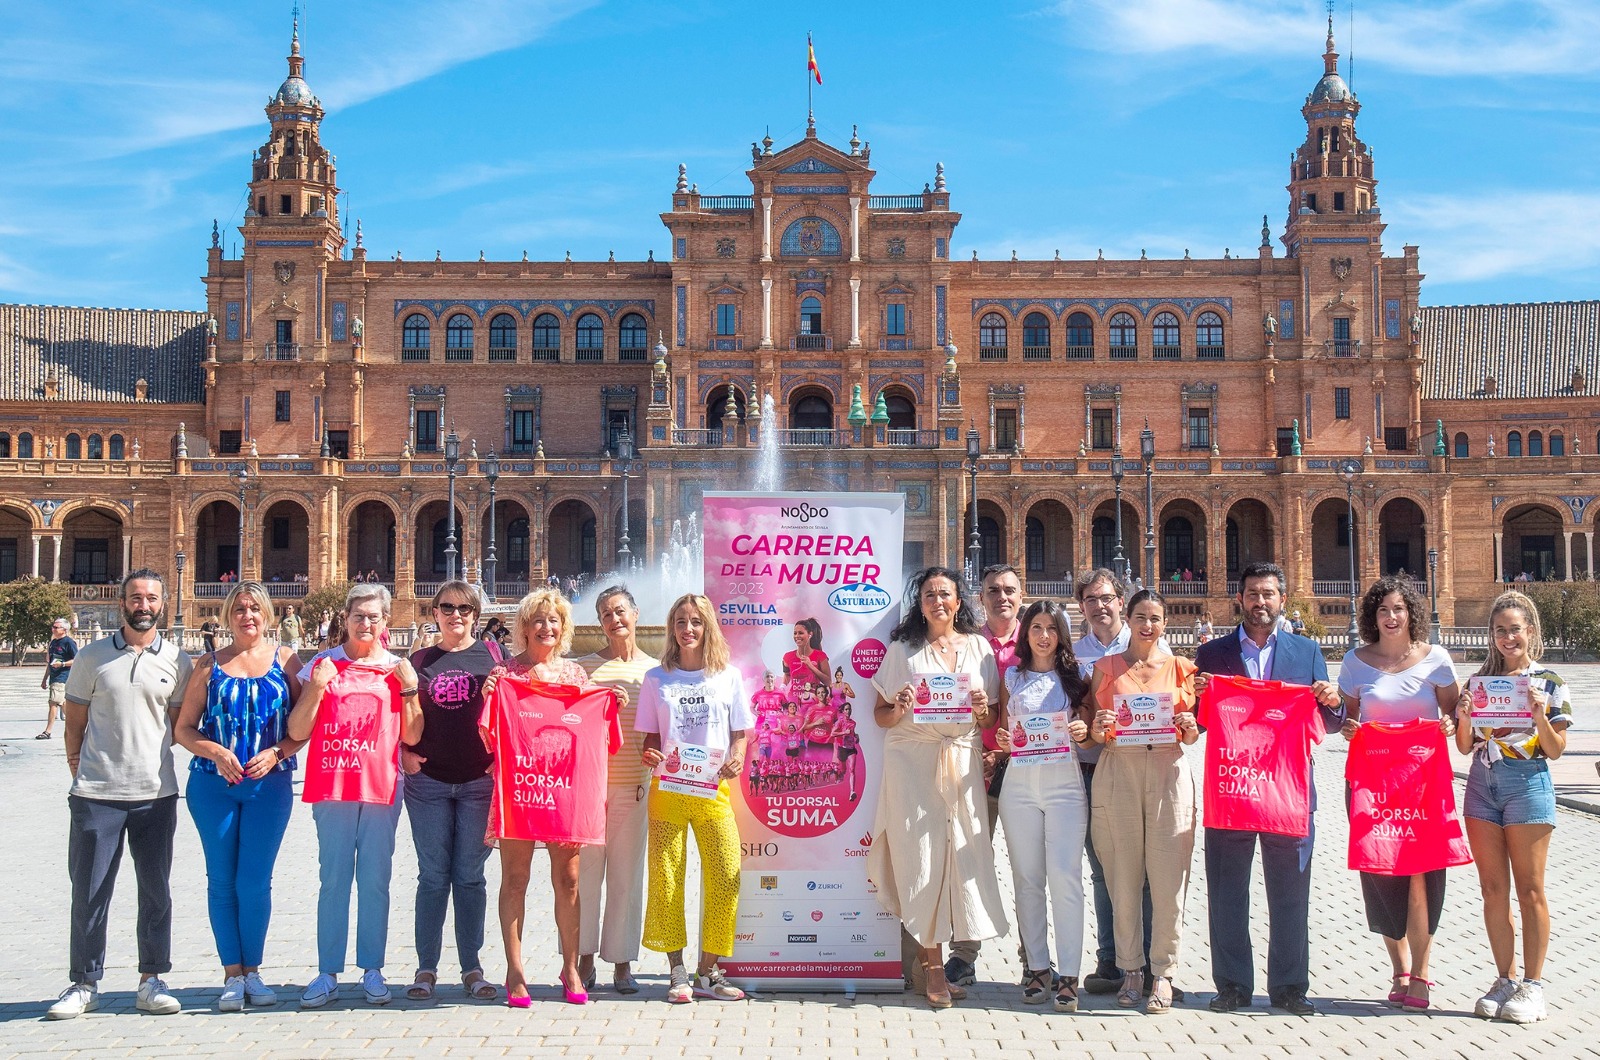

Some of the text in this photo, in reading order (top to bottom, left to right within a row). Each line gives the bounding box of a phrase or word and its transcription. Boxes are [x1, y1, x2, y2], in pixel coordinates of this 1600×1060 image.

[732, 534, 874, 556] CARRERA
[721, 564, 881, 585] DE LA MUJER
[728, 582, 764, 595] 2023
[833, 594, 886, 605] ASTURIANA
[720, 604, 777, 614] SEVILLA
[434, 681, 469, 691] CAN
[435, 690, 470, 703] CER
[679, 696, 705, 704] con
[324, 723, 339, 735] TU
[1029, 733, 1049, 742] 016
[323, 739, 376, 752] DORSAL
[1219, 748, 1236, 760] TU
[322, 756, 361, 769] SUMA
[516, 755, 532, 768] TU
[682, 764, 702, 773] 016
[1219, 765, 1274, 784] DORSAL
[515, 773, 571, 788] DORSAL
[1219, 781, 1259, 797] SUMA
[514, 790, 555, 805] SUMA
[766, 796, 839, 806] TU DORSAL
[1370, 792, 1386, 804] TU
[767, 809, 838, 827] SUMA
[1371, 809, 1428, 820] DORSAL
[1372, 824, 1415, 837] SUMA
[740, 842, 778, 857] SHO
[735, 933, 755, 941] njoy!
[738, 964, 863, 973] www.carreradelamujer.com
